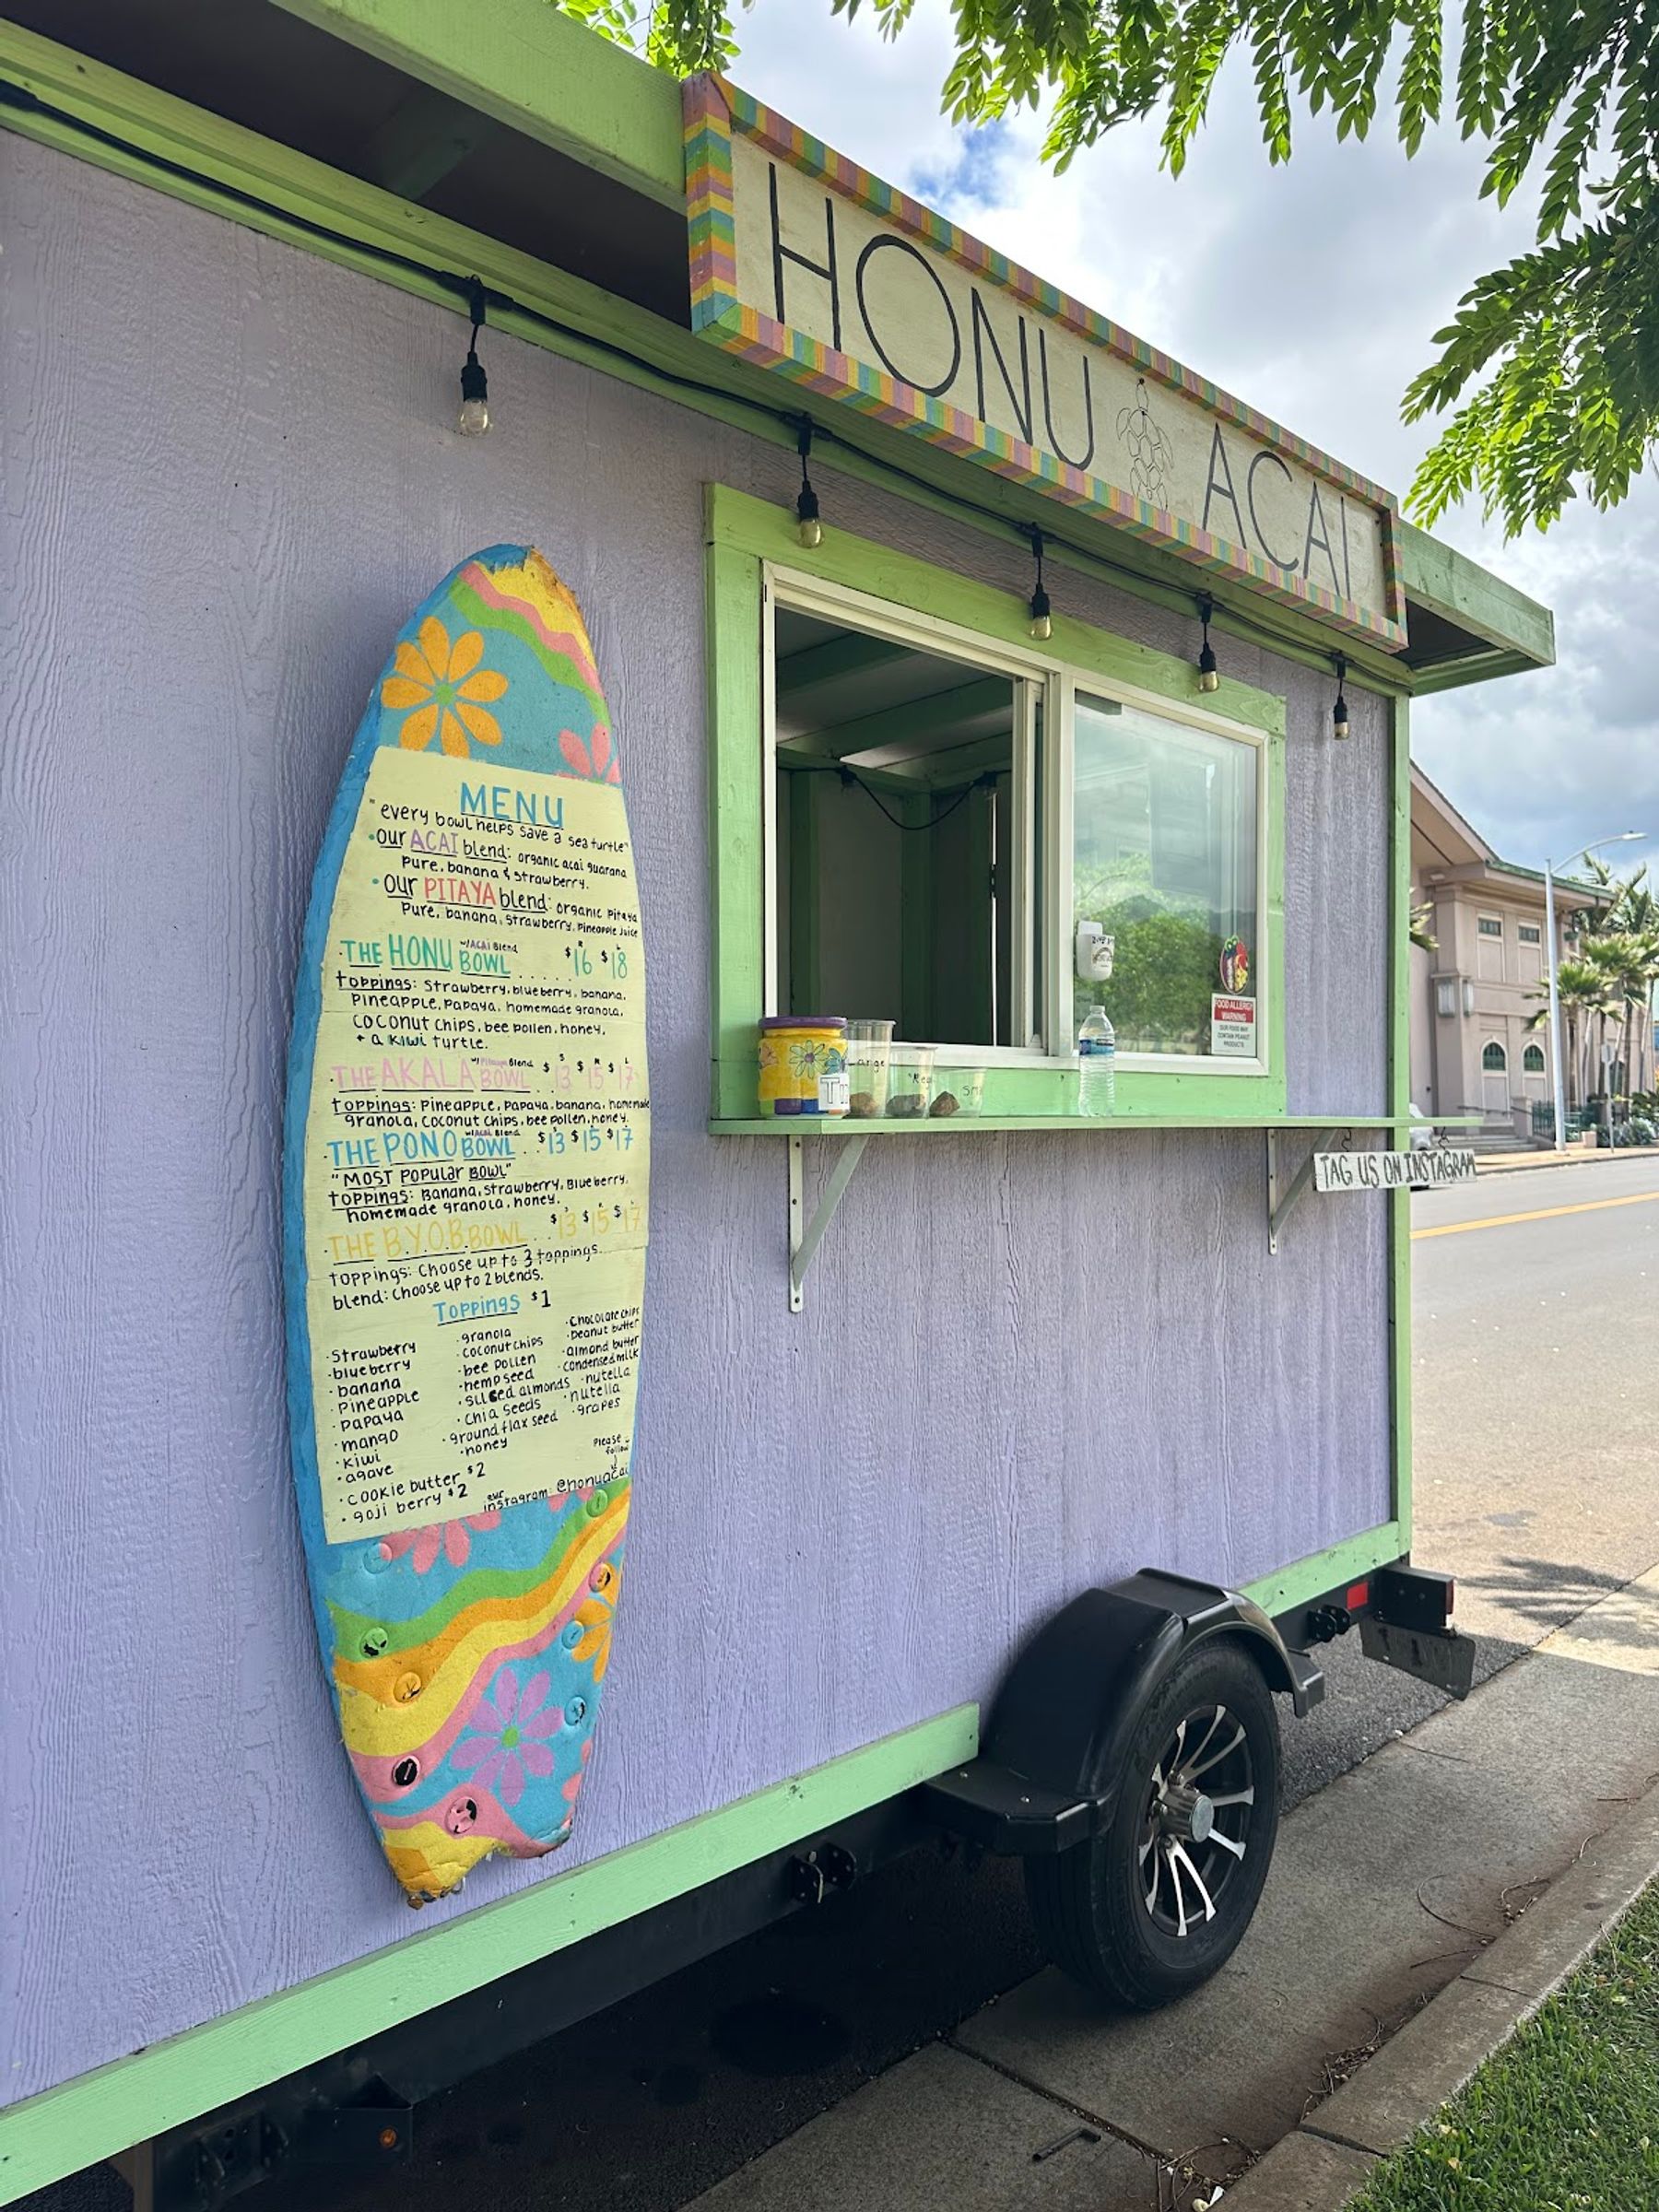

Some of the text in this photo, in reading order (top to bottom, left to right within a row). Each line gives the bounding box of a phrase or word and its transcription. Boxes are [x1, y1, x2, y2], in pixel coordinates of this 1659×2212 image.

[769, 161, 1353, 601] HONU ACAI
[461, 782, 563, 828] MENU
[435, 812, 472, 830] bowl
[477, 818, 514, 837] helps
[520, 826, 549, 841] save
[554, 832, 561, 843] a
[569, 836, 588, 849] sea
[376, 829, 628, 878] our ACAI blend: organic acai guarana
[448, 861, 499, 878] banana
[424, 877, 497, 906] PITAYA
[500, 888, 552, 912] blend:
[557, 902, 602, 919] organic
[607, 908, 638, 923] pitaya
[577, 922, 618, 936] pineapple
[619, 926, 638, 938] juice
[340, 940, 382, 964] THE
[388, 933, 453, 969] HONU
[459, 950, 511, 974] BOWL
[335, 971, 417, 990] toppings:
[353, 1015, 429, 1031] coconut
[484, 1022, 509, 1033] bee
[506, 1001, 571, 1015] homemade
[371, 1033, 383, 1046] a
[387, 1033, 427, 1047] kiwi
[331, 1065, 376, 1088] THE
[382, 1056, 477, 1088] AKALA
[480, 1068, 531, 1089] BOWL
[332, 1095, 417, 1113] toppings:
[422, 1114, 479, 1127] coconut
[526, 1115, 547, 1125] bee
[326, 1138, 380, 1166] THE
[383, 1130, 457, 1162] PONO
[462, 1136, 515, 1158] BOWL
[1320, 1150, 1476, 1189] TAG US ON INSTAGRAM
[328, 1191, 413, 1206] toppings:
[347, 1205, 438, 1223] homemade
[328, 1221, 528, 1260] THE BOWL
[329, 1266, 412, 1287] toppings:
[418, 1259, 472, 1277] choose
[477, 1254, 497, 1269] up
[501, 1253, 517, 1267] to
[524, 1249, 533, 1267] 3
[333, 1290, 388, 1311] blend:
[393, 1281, 441, 1300] choose
[444, 1277, 462, 1291] up
[465, 1275, 480, 1288] to
[486, 1273, 492, 1286] 2
[432, 1294, 521, 1322] Toppings
[462, 1319, 640, 1344] granola peanut butter
[570, 1306, 640, 1326] chocolate chips
[332, 1335, 639, 1362] strawberry coconut chips almond butter
[333, 1347, 640, 1379] blueberry bee pollen condensed milk
[337, 1366, 630, 1397] banana hemp seed nutella
[338, 1390, 419, 1414] pineapple
[519, 1377, 571, 1393] almonds
[570, 1382, 620, 1403] nutella
[341, 1396, 620, 1432] papaya chia seeds grapes
[342, 1410, 559, 1452] mango ground flax seed
[344, 1449, 382, 1469] kiwi
[465, 1437, 508, 1456] honey
[346, 1465, 394, 1484] agave
[347, 1482, 406, 1506] cookie
[409, 1472, 461, 1492] butter
[354, 1503, 387, 1524] goji
[396, 1492, 442, 1514] berry
